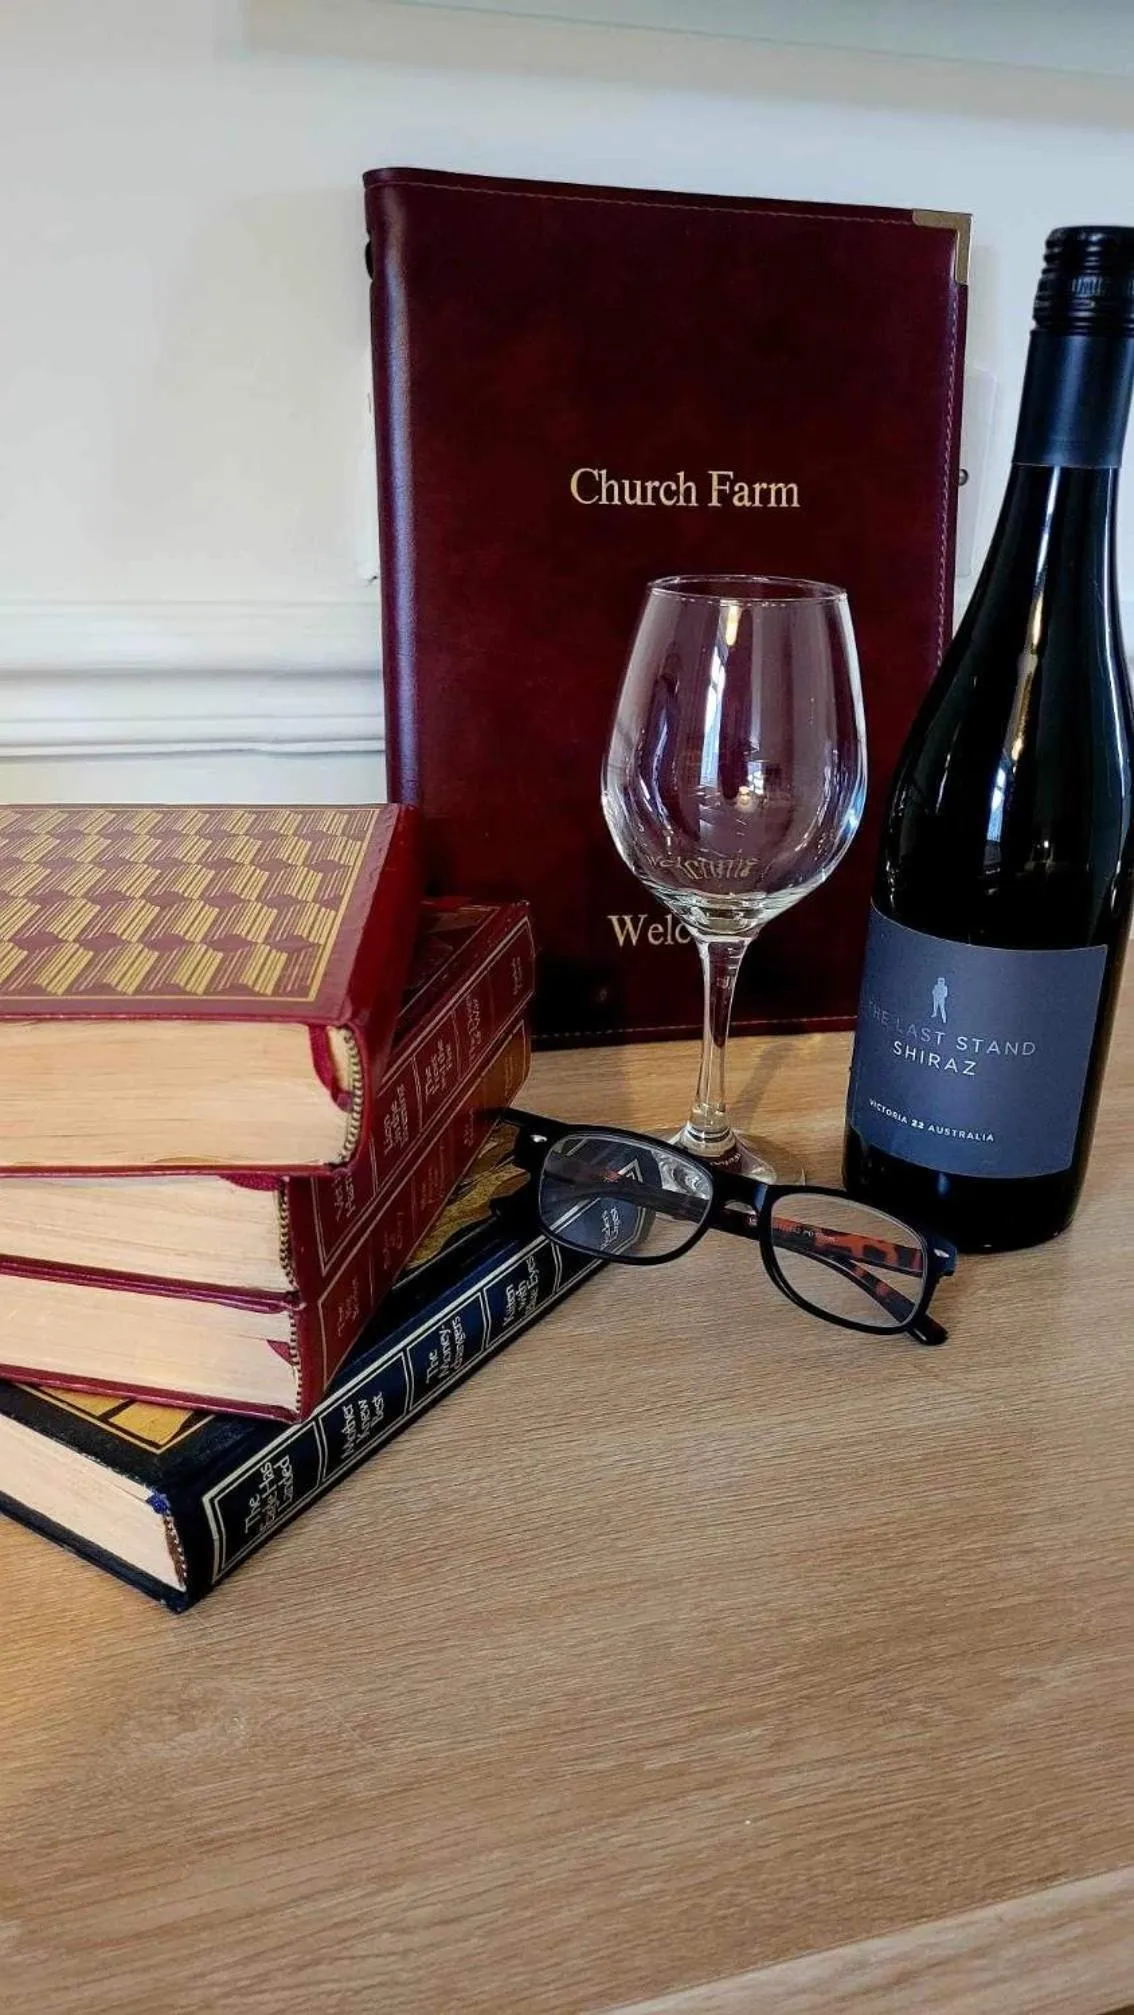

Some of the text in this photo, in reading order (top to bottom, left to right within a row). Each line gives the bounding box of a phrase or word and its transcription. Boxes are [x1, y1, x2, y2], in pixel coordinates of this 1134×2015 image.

[569, 467, 801, 508] Church Farm
[606, 913, 693, 949] Welc
[897, 1018, 946, 1046] LAST
[955, 1035, 1036, 1057] STAND
[892, 1040, 977, 1076] SHIRAZ
[869, 1097, 995, 1143] VICTORIA 22 AUSTRALIA
[425, 1349, 439, 1384] The
[341, 1404, 357, 1459] Mother
[258, 1462, 278, 1499] Has
[243, 1493, 261, 1534] The
